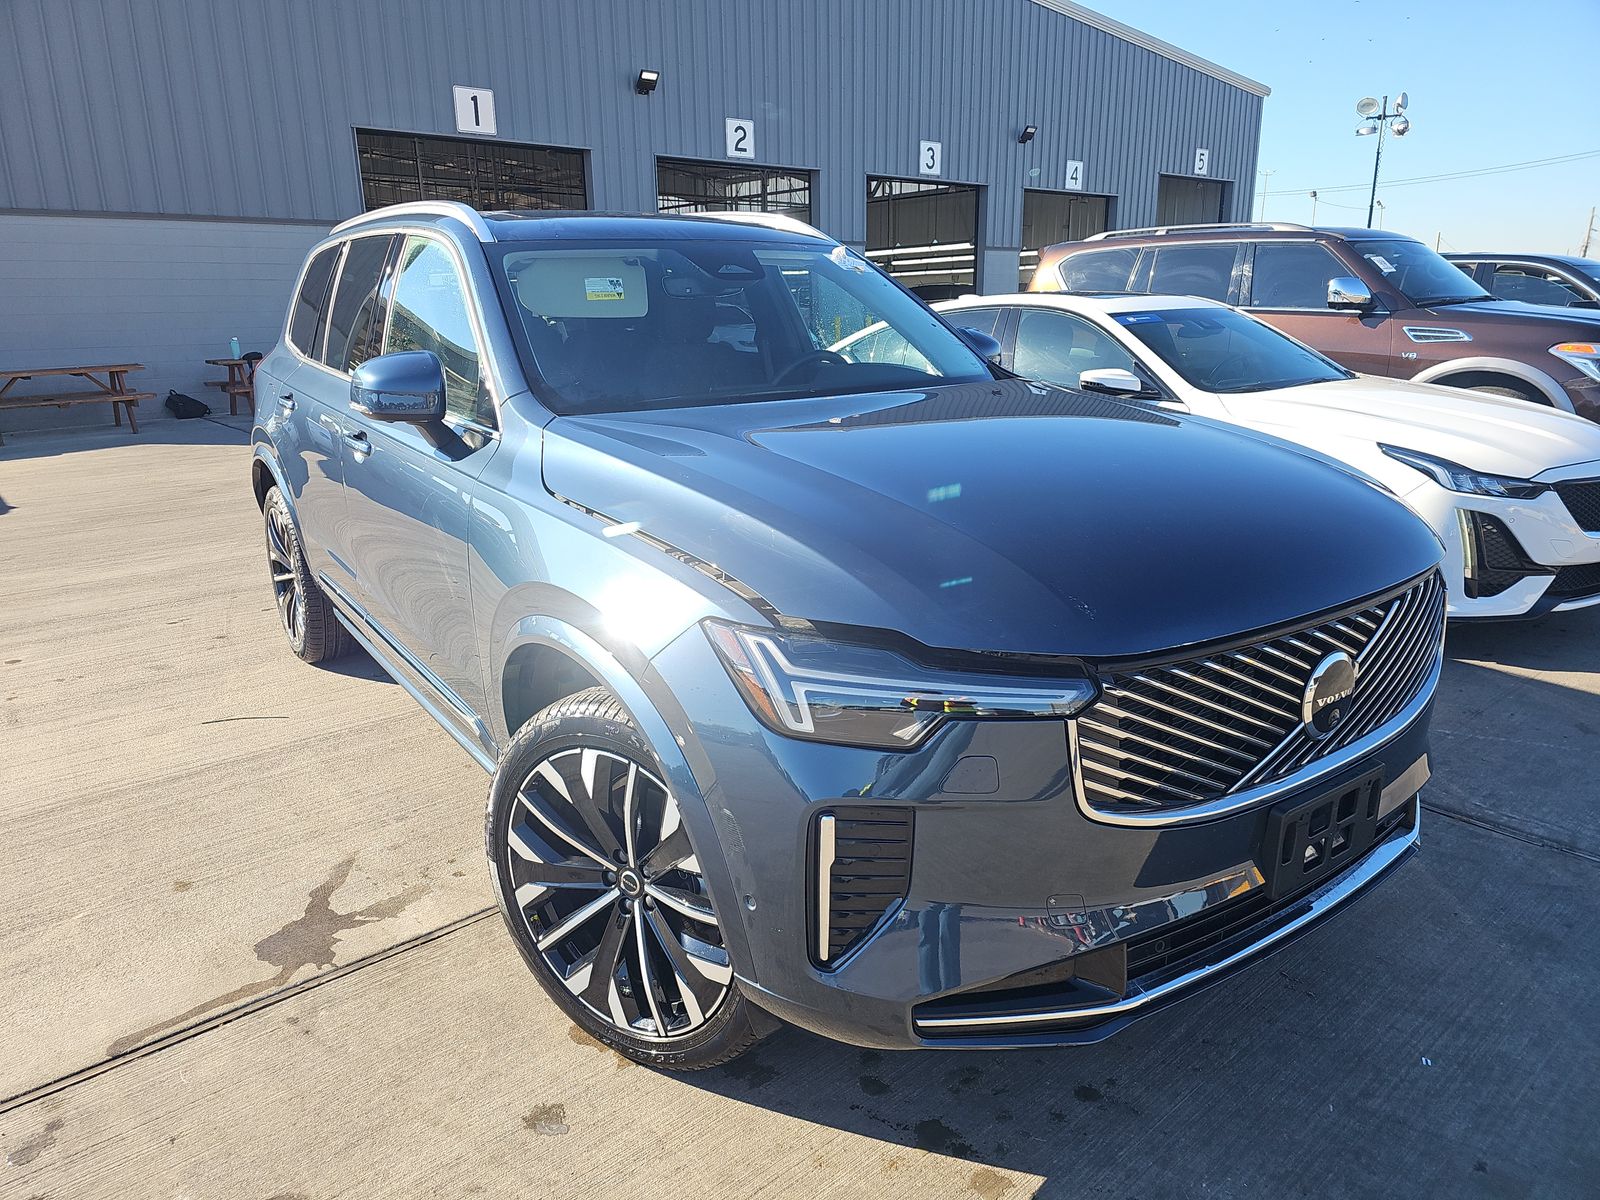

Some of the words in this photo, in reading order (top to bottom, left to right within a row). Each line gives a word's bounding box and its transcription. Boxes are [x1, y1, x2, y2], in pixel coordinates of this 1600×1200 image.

[470, 95, 481, 127] 1
[734, 125, 748, 153] 2
[925, 146, 936, 170] 3
[1198, 152, 1205, 171] 5
[1070, 165, 1079, 186] 4
